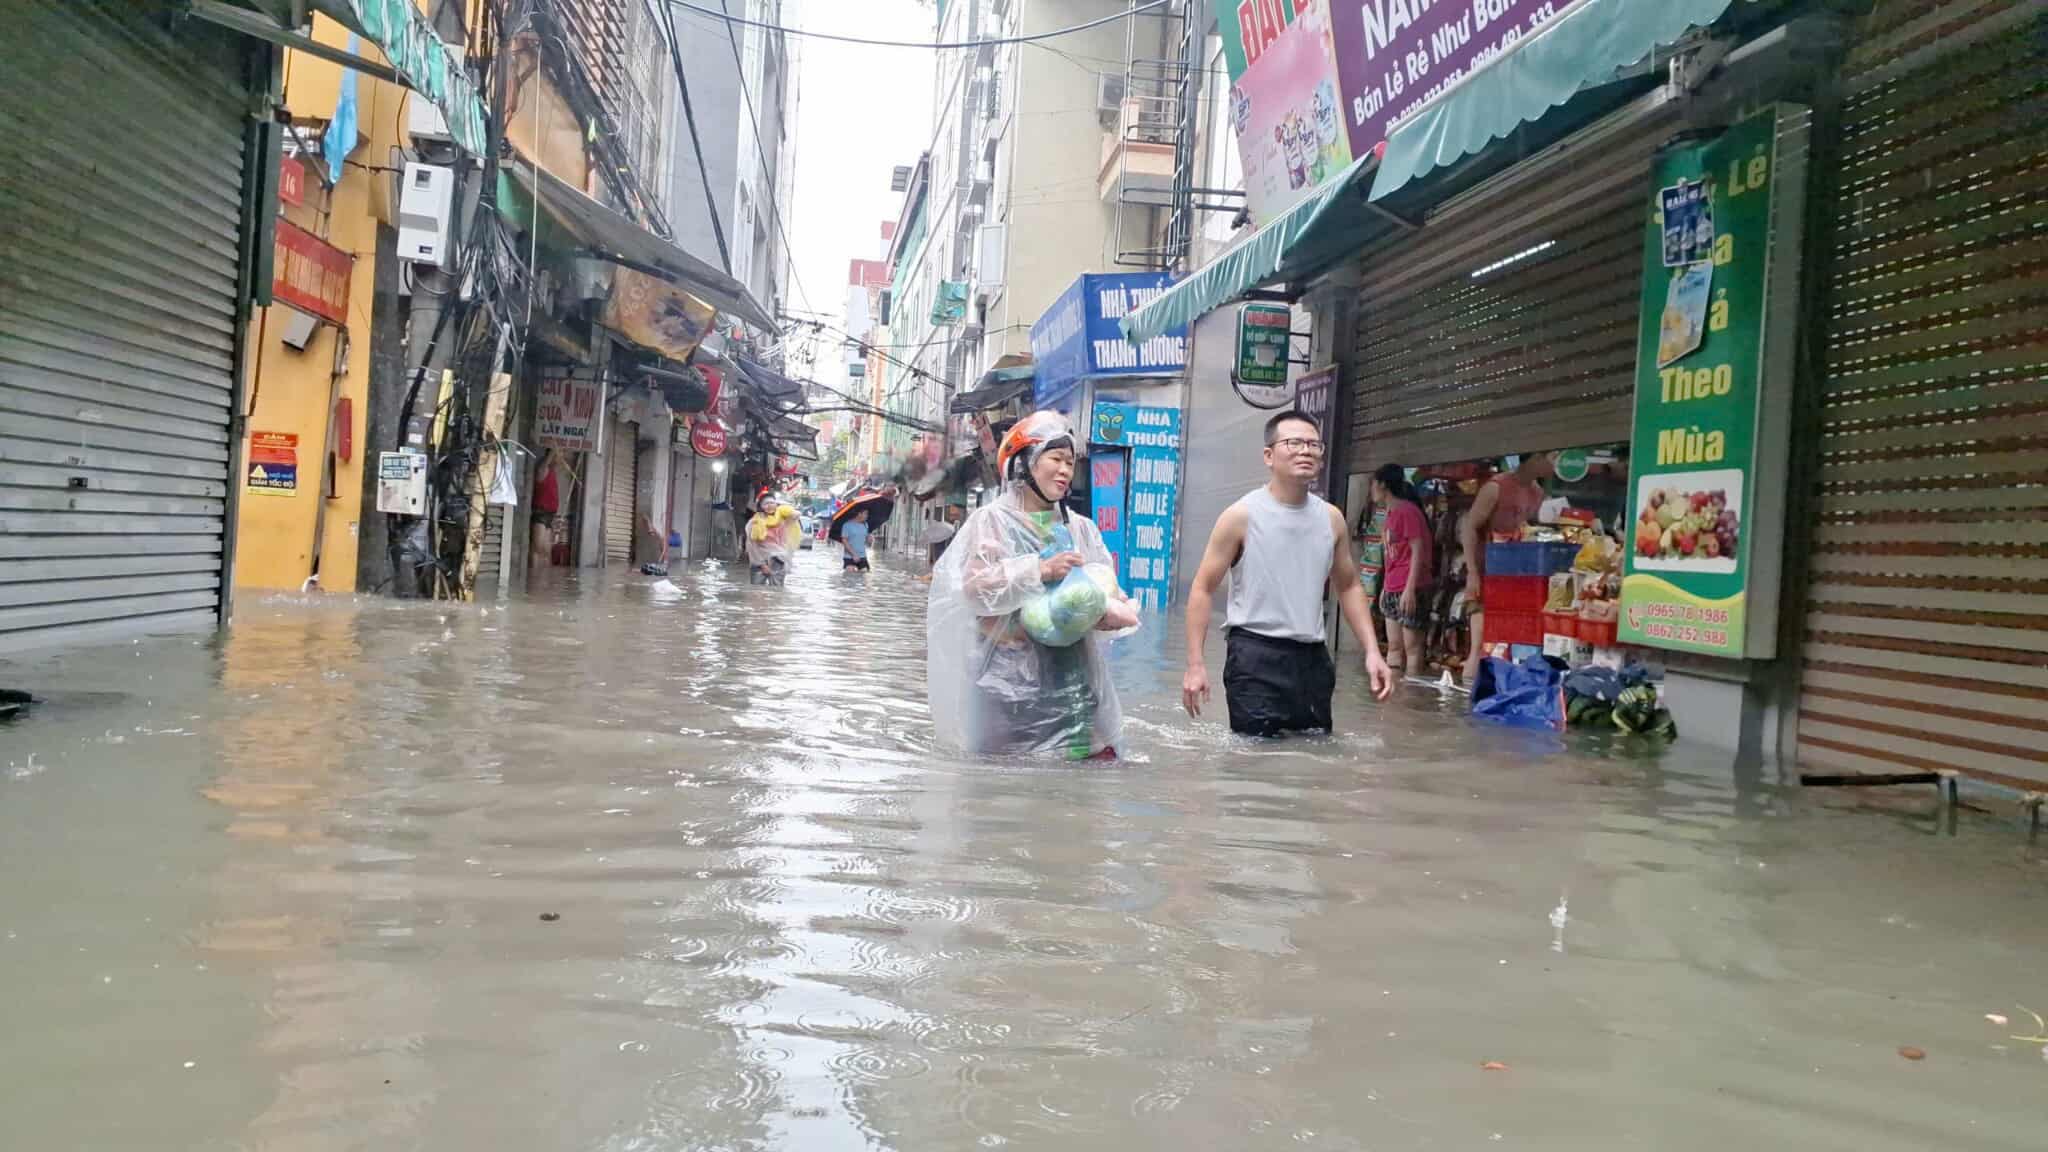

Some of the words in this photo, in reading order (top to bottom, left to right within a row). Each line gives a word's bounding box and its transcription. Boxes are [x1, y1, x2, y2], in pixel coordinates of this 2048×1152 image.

[1352, 85, 1383, 127] Bán
[1384, 60, 1403, 101] Lẻ
[1405, 39, 1429, 86] Rẻ
[1431, 9, 1471, 64] Như
[1727, 143, 1767, 197] Lẻ
[1100, 282, 1128, 319] NHÀ
[1093, 338, 1137, 369] THANH
[1658, 364, 1733, 403] Theo
[1300, 388, 1328, 414] NAM
[1126, 430, 1180, 447] THUỐC
[1656, 425, 1725, 466] Mùa
[1134, 488, 1154, 515] BÁN
[1136, 519, 1164, 550] THUỐC
